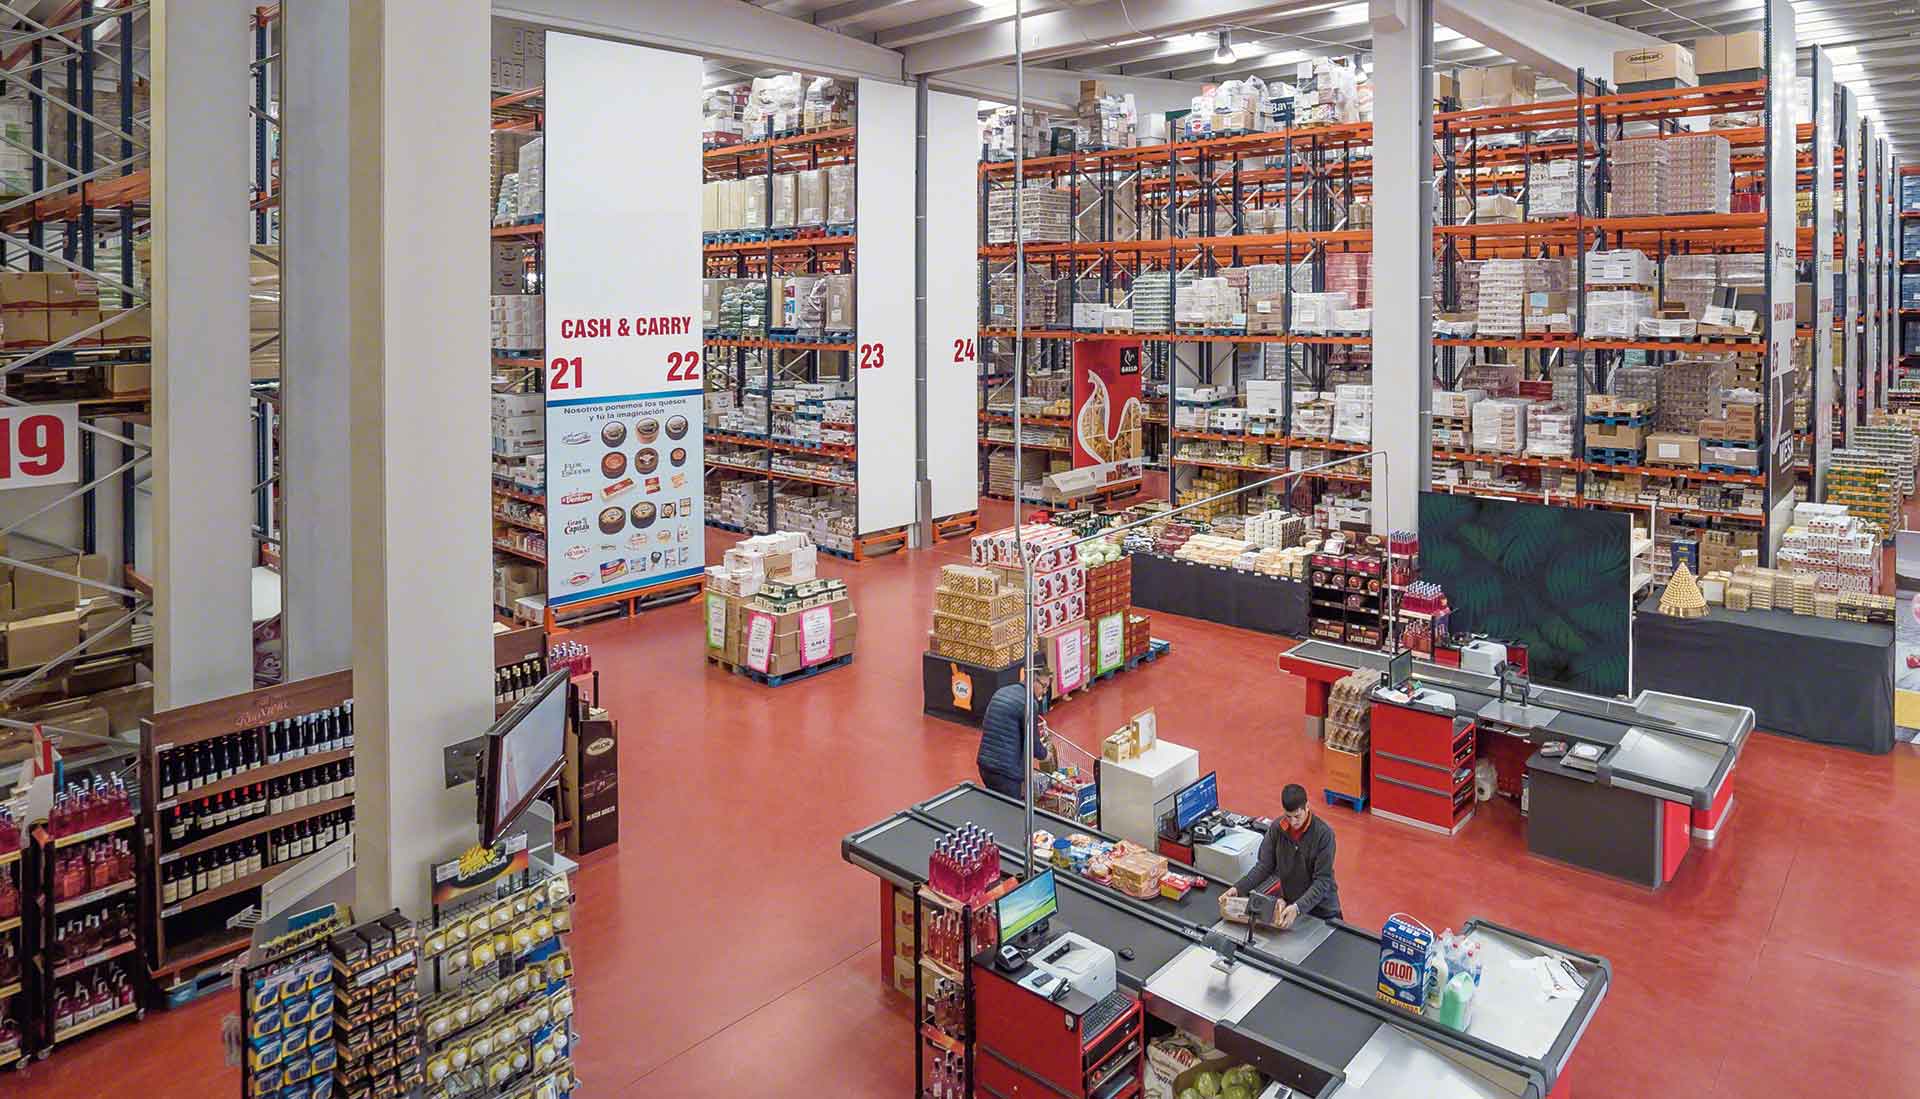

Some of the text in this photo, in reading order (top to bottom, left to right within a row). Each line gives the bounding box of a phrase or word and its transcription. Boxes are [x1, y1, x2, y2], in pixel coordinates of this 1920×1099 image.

[561, 316, 691, 339] CASH & CARRY
[860, 343, 885, 369] 23
[953, 338, 975, 363] 24
[550, 356, 583, 390] 21
[666, 350, 700, 382] 22
[563, 399, 687, 415] Nosotros ponemos los quesos
[607, 412, 615, 420] la
[616, 408, 665, 419] imaginación
[1383, 960, 1413, 981] COLON
